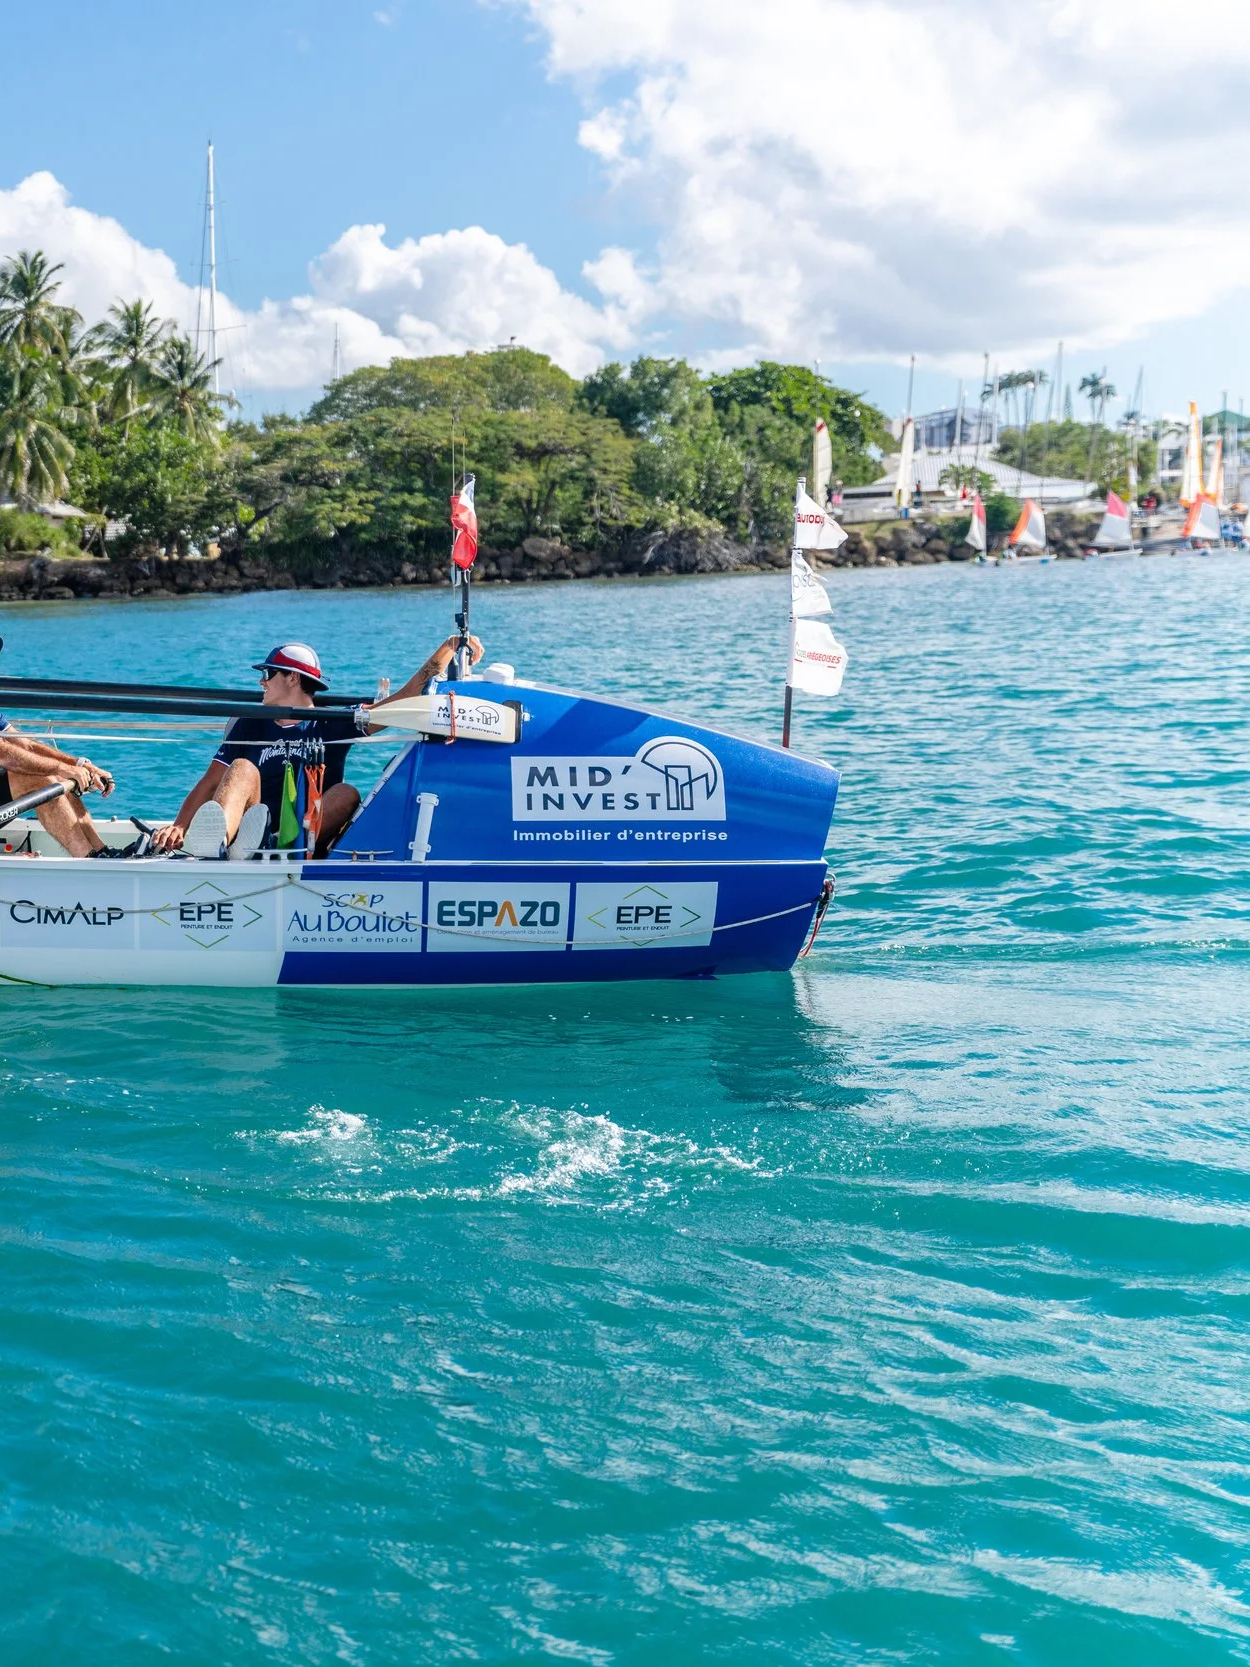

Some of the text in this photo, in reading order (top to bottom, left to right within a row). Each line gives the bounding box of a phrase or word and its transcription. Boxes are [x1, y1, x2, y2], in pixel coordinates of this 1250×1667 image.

[438, 706, 472, 714] MD'
[526, 792, 661, 811] INVEST
[513, 829, 728, 843] Immobilier d'entreprise
[179, 902, 234, 921] EPE
[437, 900, 561, 927] ESPAZO
[616, 905, 673, 924] EPE
[292, 935, 413, 944] Agence d'emploi
